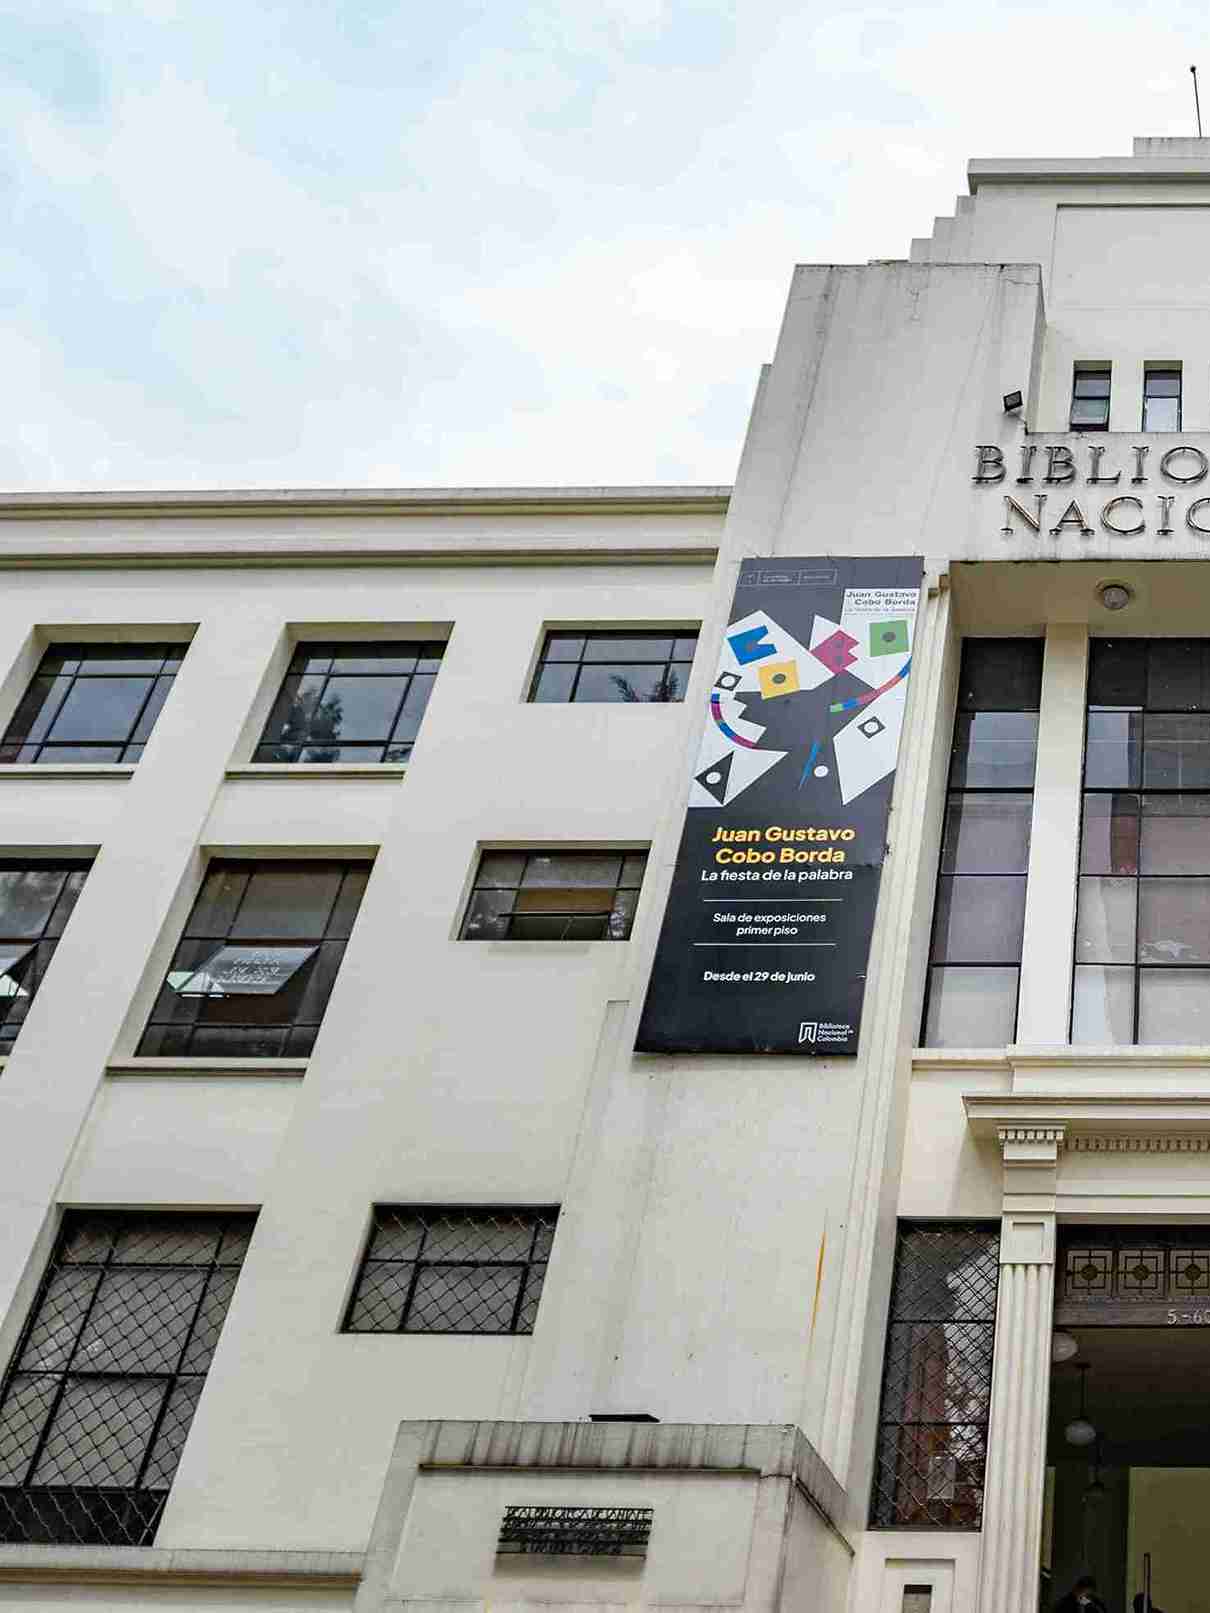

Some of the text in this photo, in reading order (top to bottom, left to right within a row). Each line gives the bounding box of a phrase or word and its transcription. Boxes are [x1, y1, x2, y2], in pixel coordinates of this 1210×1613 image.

[712, 826, 855, 842] Juan Gustavo
[715, 848, 845, 863] Cobo Borda
[701, 869, 853, 883] La fiesta de la palabra
[712, 912, 827, 924] Sala de exposiciones
[736, 925, 798, 937] primer piso
[703, 970, 815, 983] Desde el 29 de junio
